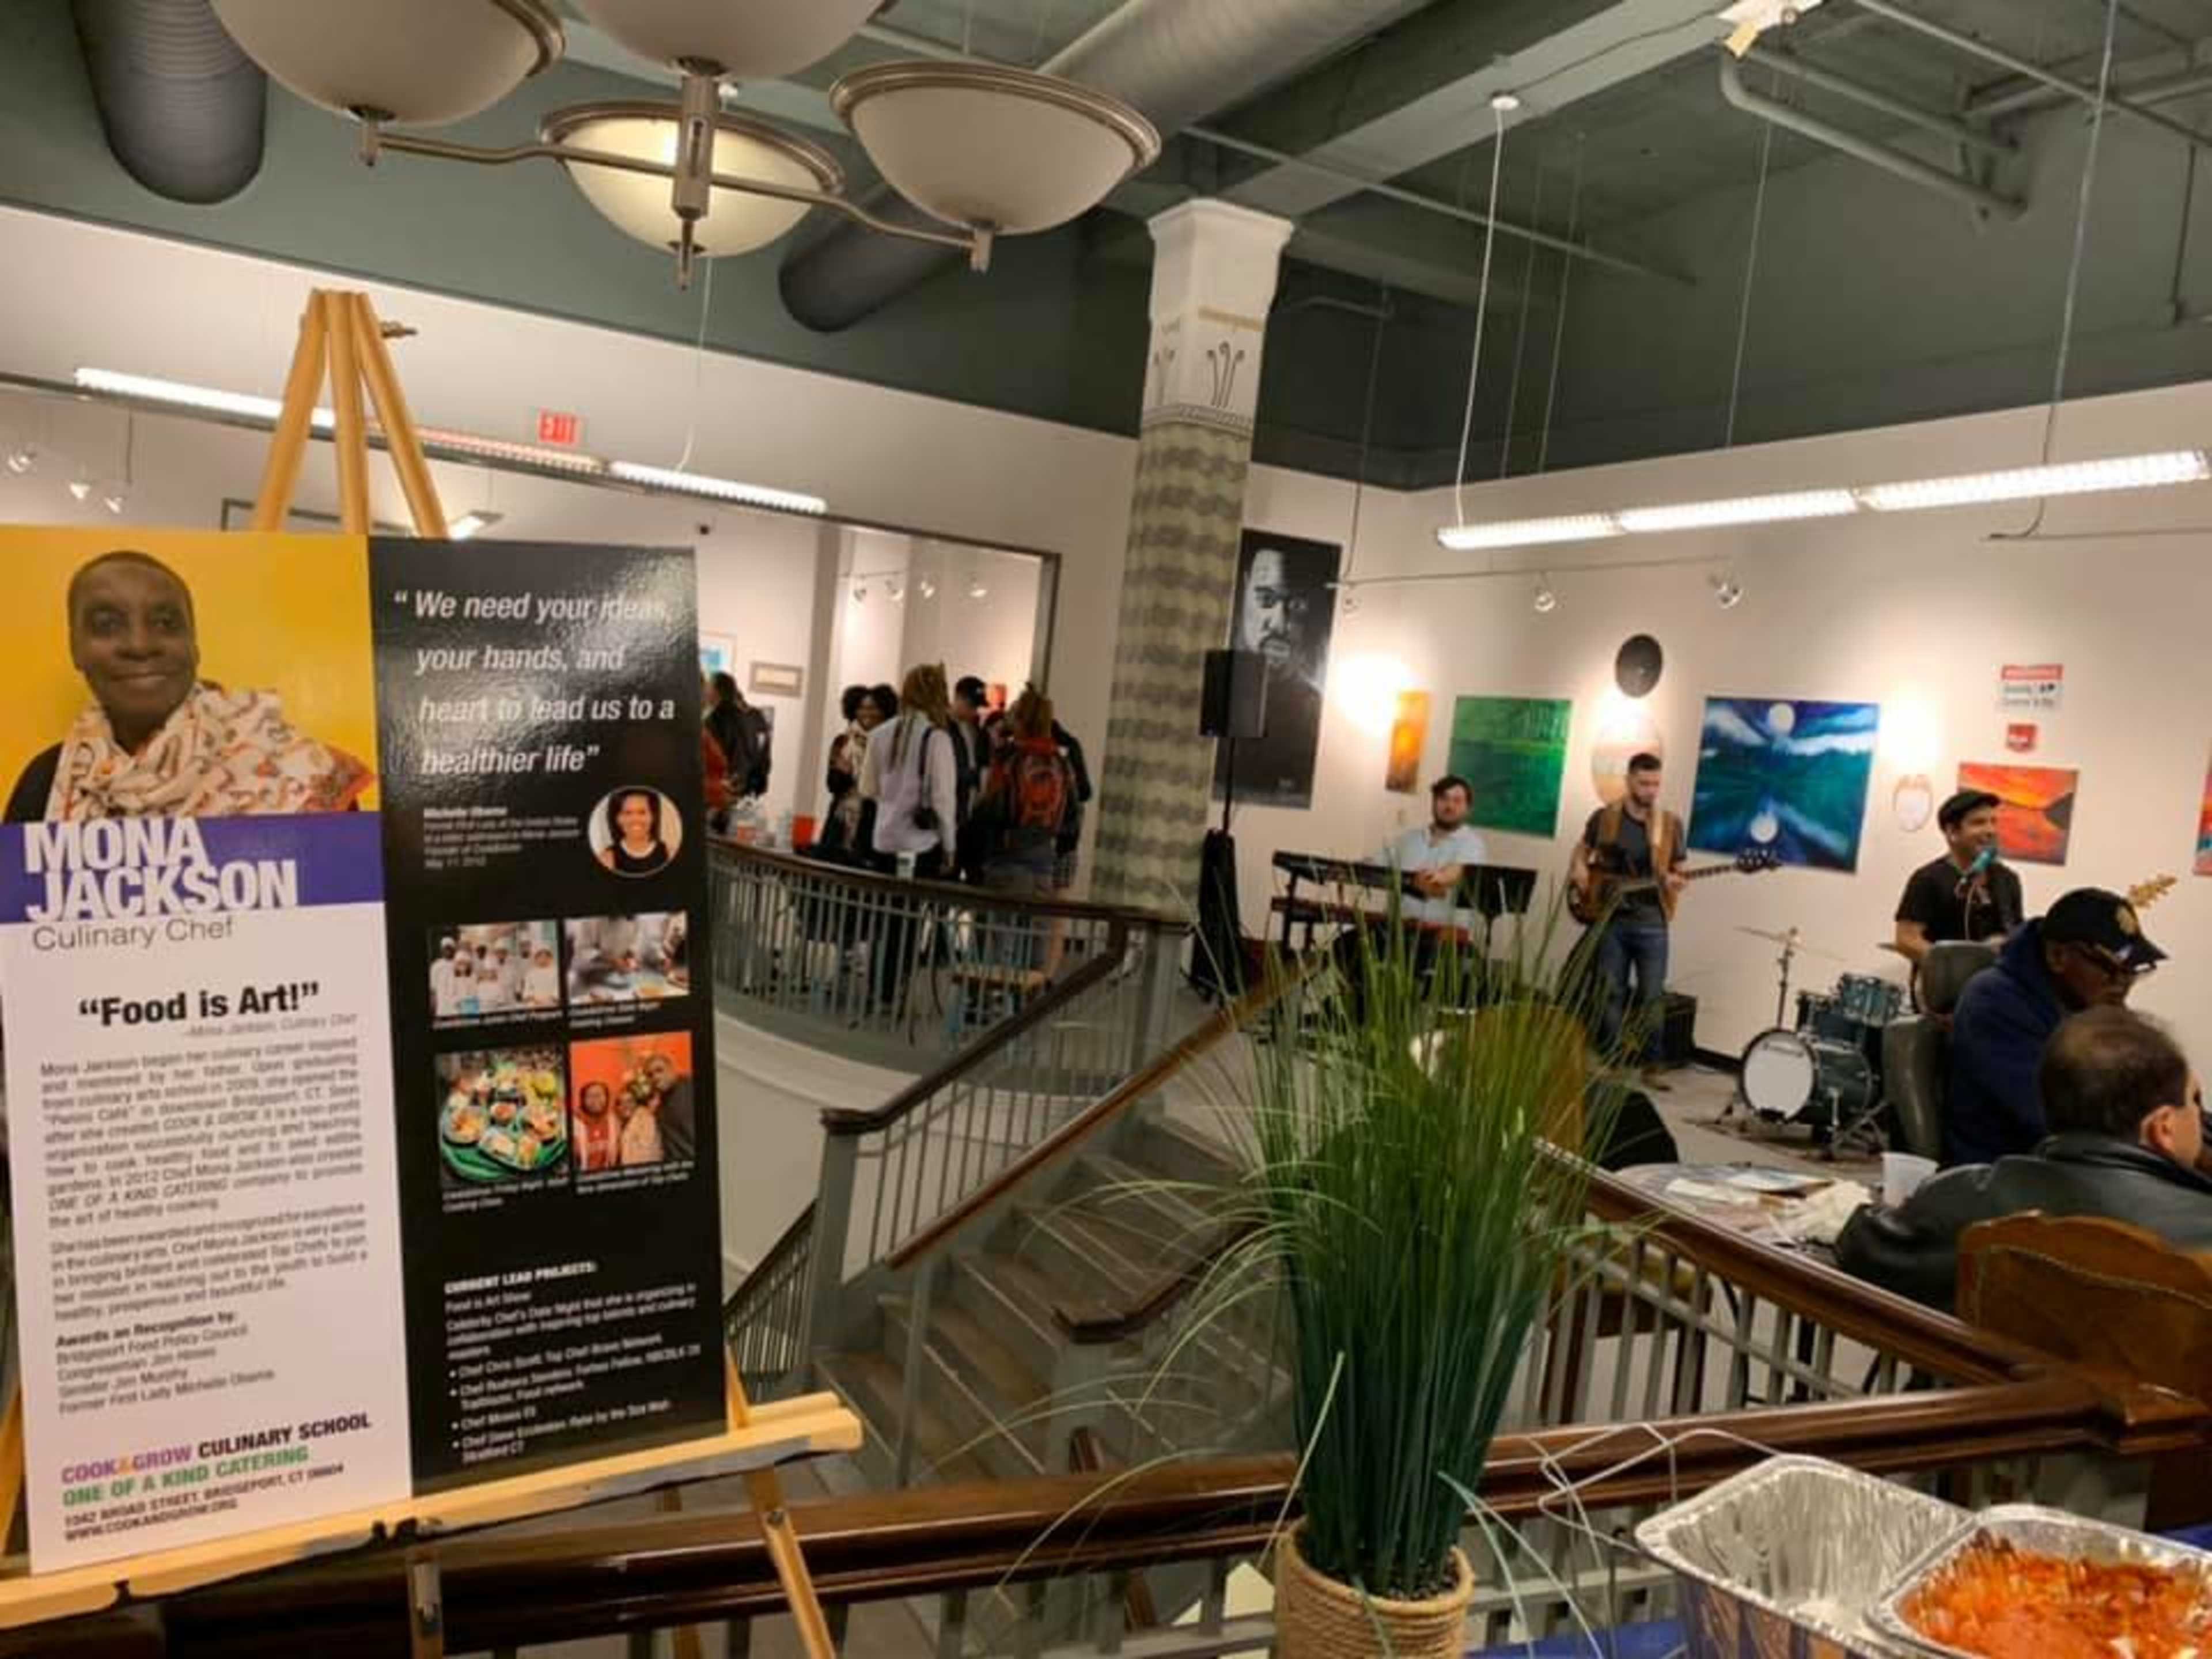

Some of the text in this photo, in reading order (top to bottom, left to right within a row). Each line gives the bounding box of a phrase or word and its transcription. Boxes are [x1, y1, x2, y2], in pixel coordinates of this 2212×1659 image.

[415, 590, 456, 619] We
[464, 591, 530, 620] need
[534, 597, 599, 624] your
[415, 645, 626, 676] your hands, and
[420, 697, 675, 721] heart to lead us to a
[421, 746, 600, 775] healthier life”
[22, 814, 210, 872] MONA
[26, 859, 299, 923] JACKSON
[32, 915, 235, 953] Culinary Chef
[79, 981, 319, 1027] “Food is Art!”
[198, 1427, 292, 1459] CULINARY
[298, 1413, 371, 1440] SCHOOL
[63, 1446, 309, 1506] ONE OF A KIND CATERING
